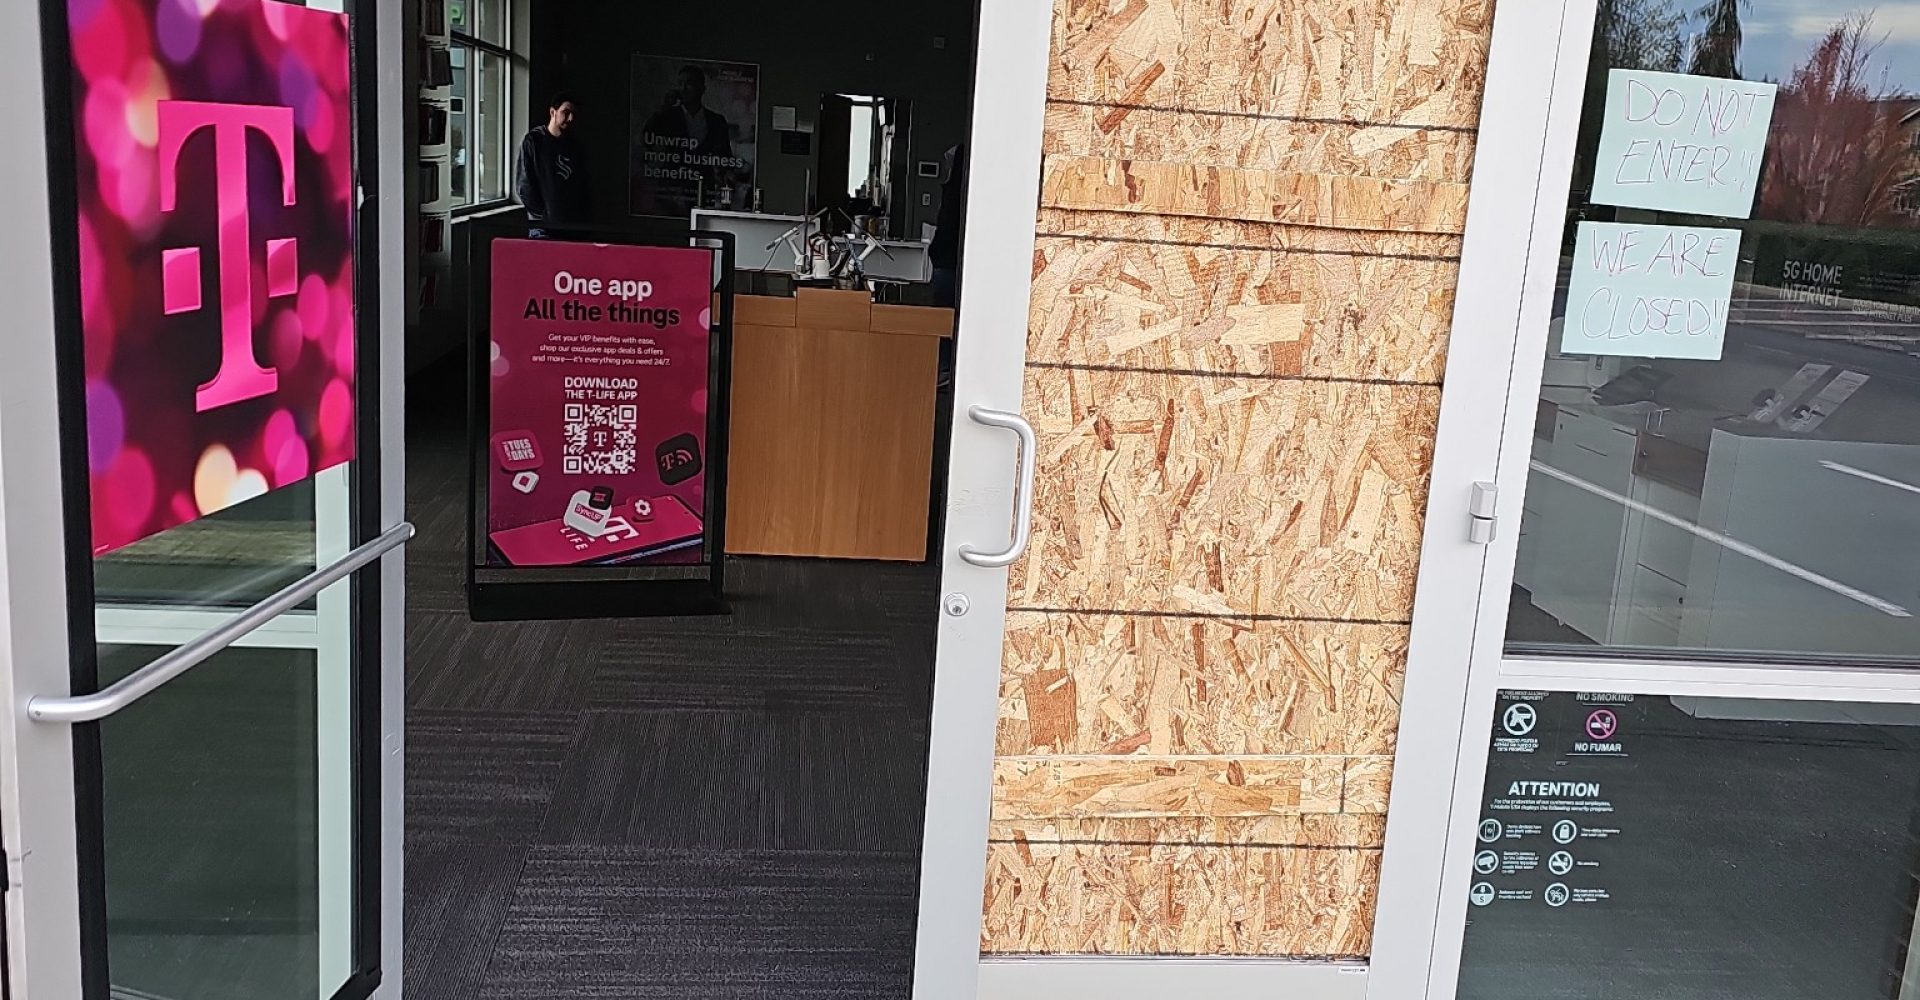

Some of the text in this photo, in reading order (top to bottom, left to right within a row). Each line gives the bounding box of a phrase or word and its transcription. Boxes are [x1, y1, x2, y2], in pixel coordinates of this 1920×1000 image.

[1625, 79, 1770, 138] DO NOT
[644, 132, 699, 150] Unwrap
[644, 150, 743, 168] more business
[157, 100, 298, 413] T
[1593, 229, 1729, 277] WE ARE
[1783, 260, 1801, 279] 5G
[1802, 262, 1844, 285] HOME
[554, 271, 652, 301] One app
[1780, 281, 1843, 307] INTERNET
[524, 298, 680, 330] All the things
[548, 333, 656, 346] Get your VIP benefits with ease,
[539, 344, 557, 352] shop
[571, 345, 602, 353] exclusive
[618, 346, 636, 354] deals
[643, 347, 664, 355] offers
[584, 356, 621, 366] everything
[622, 358, 635, 366] you
[564, 376, 638, 390] DOWNLOAD
[564, 389, 638, 400] THE T-LIFE APP
[507, 438, 531, 451] TUES
[511, 448, 535, 461] DAYS
[560, 527, 589, 551] LIFE
[1576, 692, 1635, 702] NO SMOKING
[1574, 742, 1622, 752] NO FUMAR
[1508, 780, 1600, 797] ATTENTION
